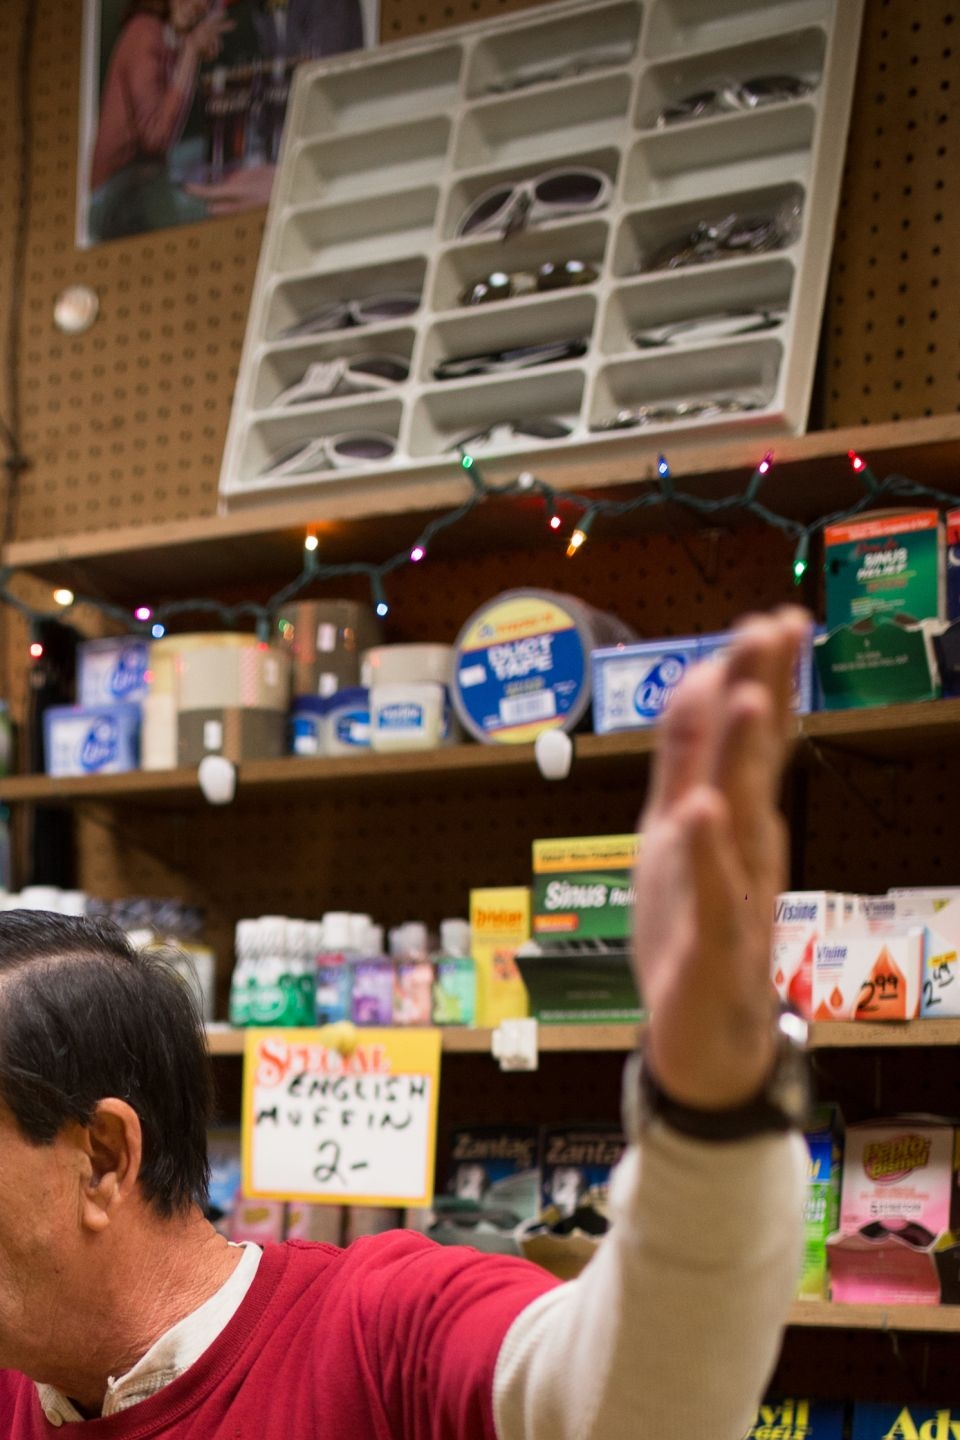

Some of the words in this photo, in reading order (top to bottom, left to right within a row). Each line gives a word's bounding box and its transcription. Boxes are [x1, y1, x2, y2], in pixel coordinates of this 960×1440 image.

[487, 633, 554, 664] DUCT
[494, 652, 553, 681] TAPE
[544, 880, 608, 910] Sinus
[774, 900, 818, 923] Visine
[287, 1072, 427, 1102] ENGLISH
[255, 1106, 413, 1130] MUFFIN
